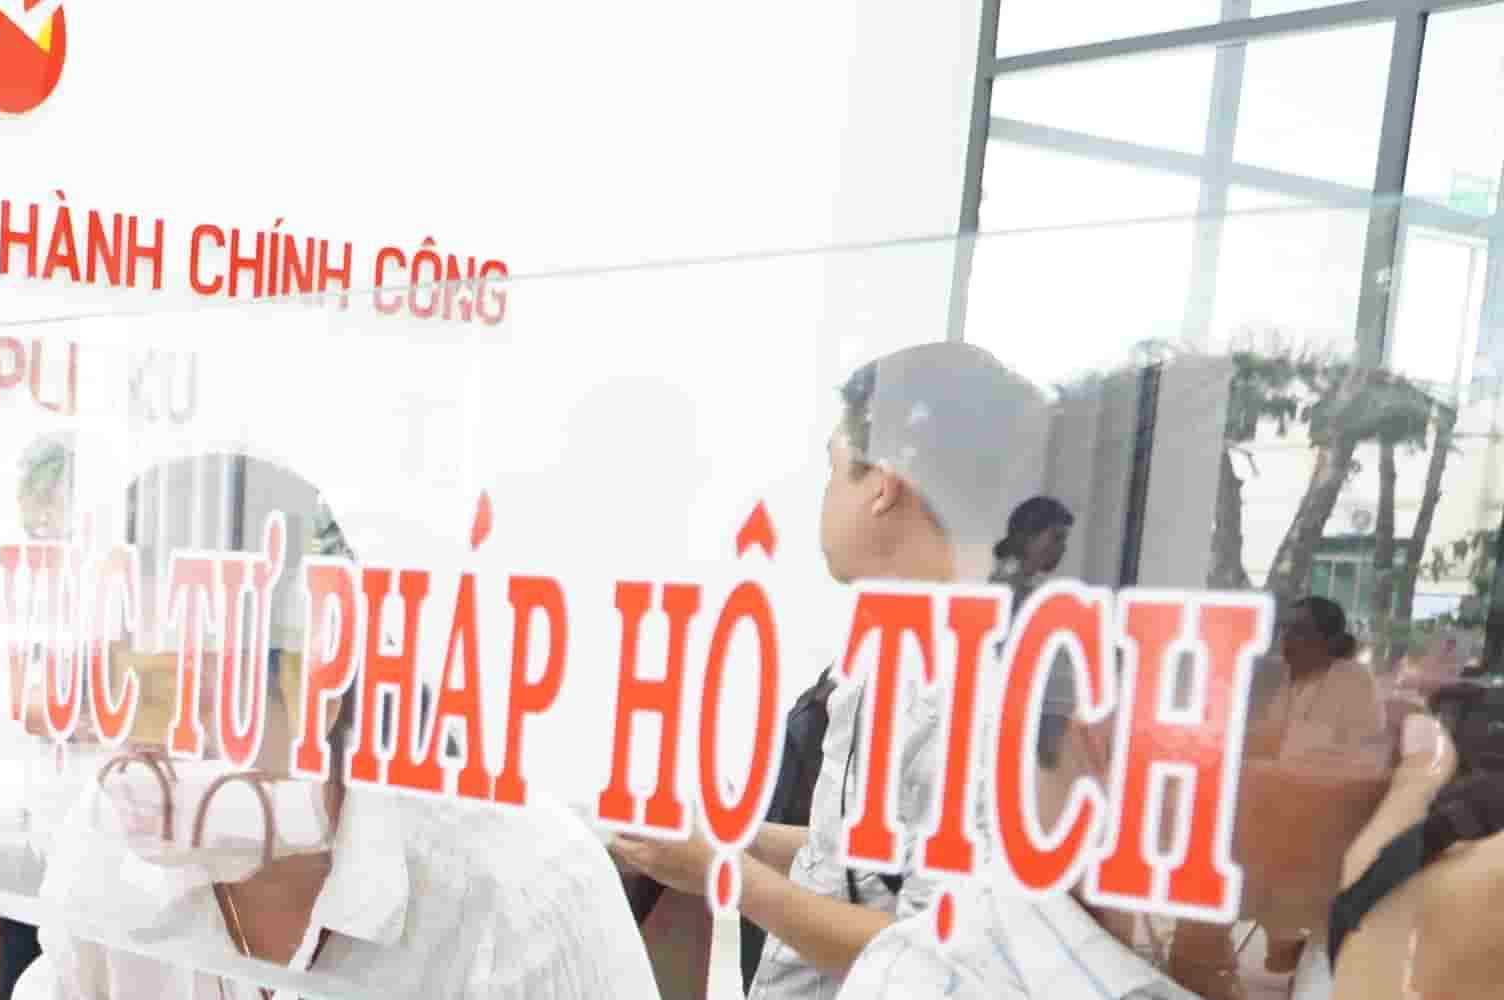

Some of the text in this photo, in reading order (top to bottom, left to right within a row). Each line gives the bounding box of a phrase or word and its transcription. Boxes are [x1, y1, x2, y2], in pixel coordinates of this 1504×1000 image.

[189, 219, 353, 307] CHÍNH
[373, 237, 510, 326] CÔNG
[170, 518, 285, 764] TƯ
[297, 491, 569, 806] PHÁP
[597, 500, 780, 906] HỘ
[841, 590, 1268, 943] TỊCH
